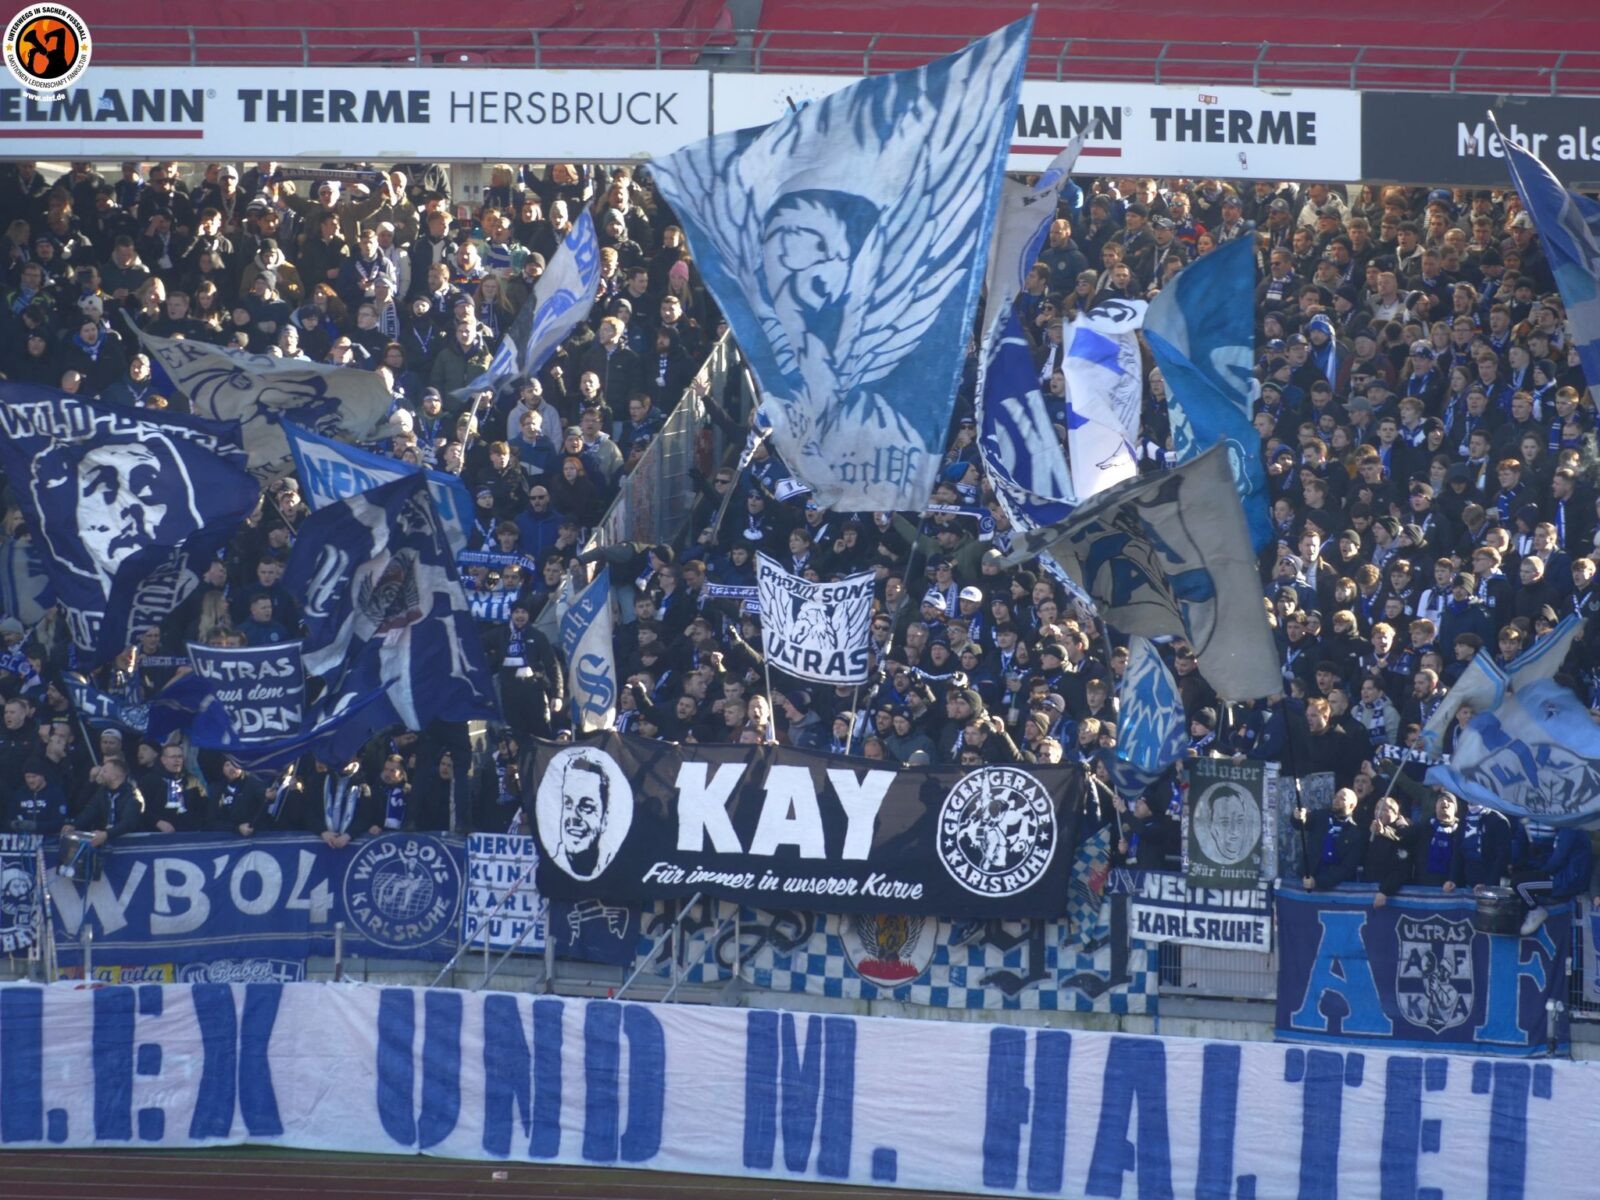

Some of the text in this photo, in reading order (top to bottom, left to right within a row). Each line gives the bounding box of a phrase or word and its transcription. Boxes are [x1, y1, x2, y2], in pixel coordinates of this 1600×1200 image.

[238, 89, 430, 123] THERME
[449, 92, 678, 126] HERSBRUCK
[1150, 107, 1317, 146] THERME
[1457, 121, 1548, 161] Mehr
[822, 580, 876, 603] SONS
[197, 657, 295, 682] ULTRAS
[768, 631, 870, 676] ULTRAS
[249, 683, 285, 699] dem
[1196, 759, 1260, 780] Moser
[676, 761, 897, 861] KAY
[988, 771, 1051, 825] GERADE
[354, 840, 448, 883] WILD BOYS
[469, 836, 538, 856] NERVE
[642, 862, 923, 900] Für immer in unserer Kurve
[945, 845, 1050, 892] KARLSRUHE
[1220, 866, 1259, 879] immer
[352, 891, 450, 940] KARLSRUHE
[467, 917, 544, 940] RUHE
[1137, 911, 1265, 945] KARLSRUHE
[1404, 924, 1466, 941] ULTRAS
[208, 959, 274, 980] Graben
[376, 988, 666, 1162] UND
[742, 1010, 898, 1183] M.
[982, 1027, 1553, 1200] HALTET
